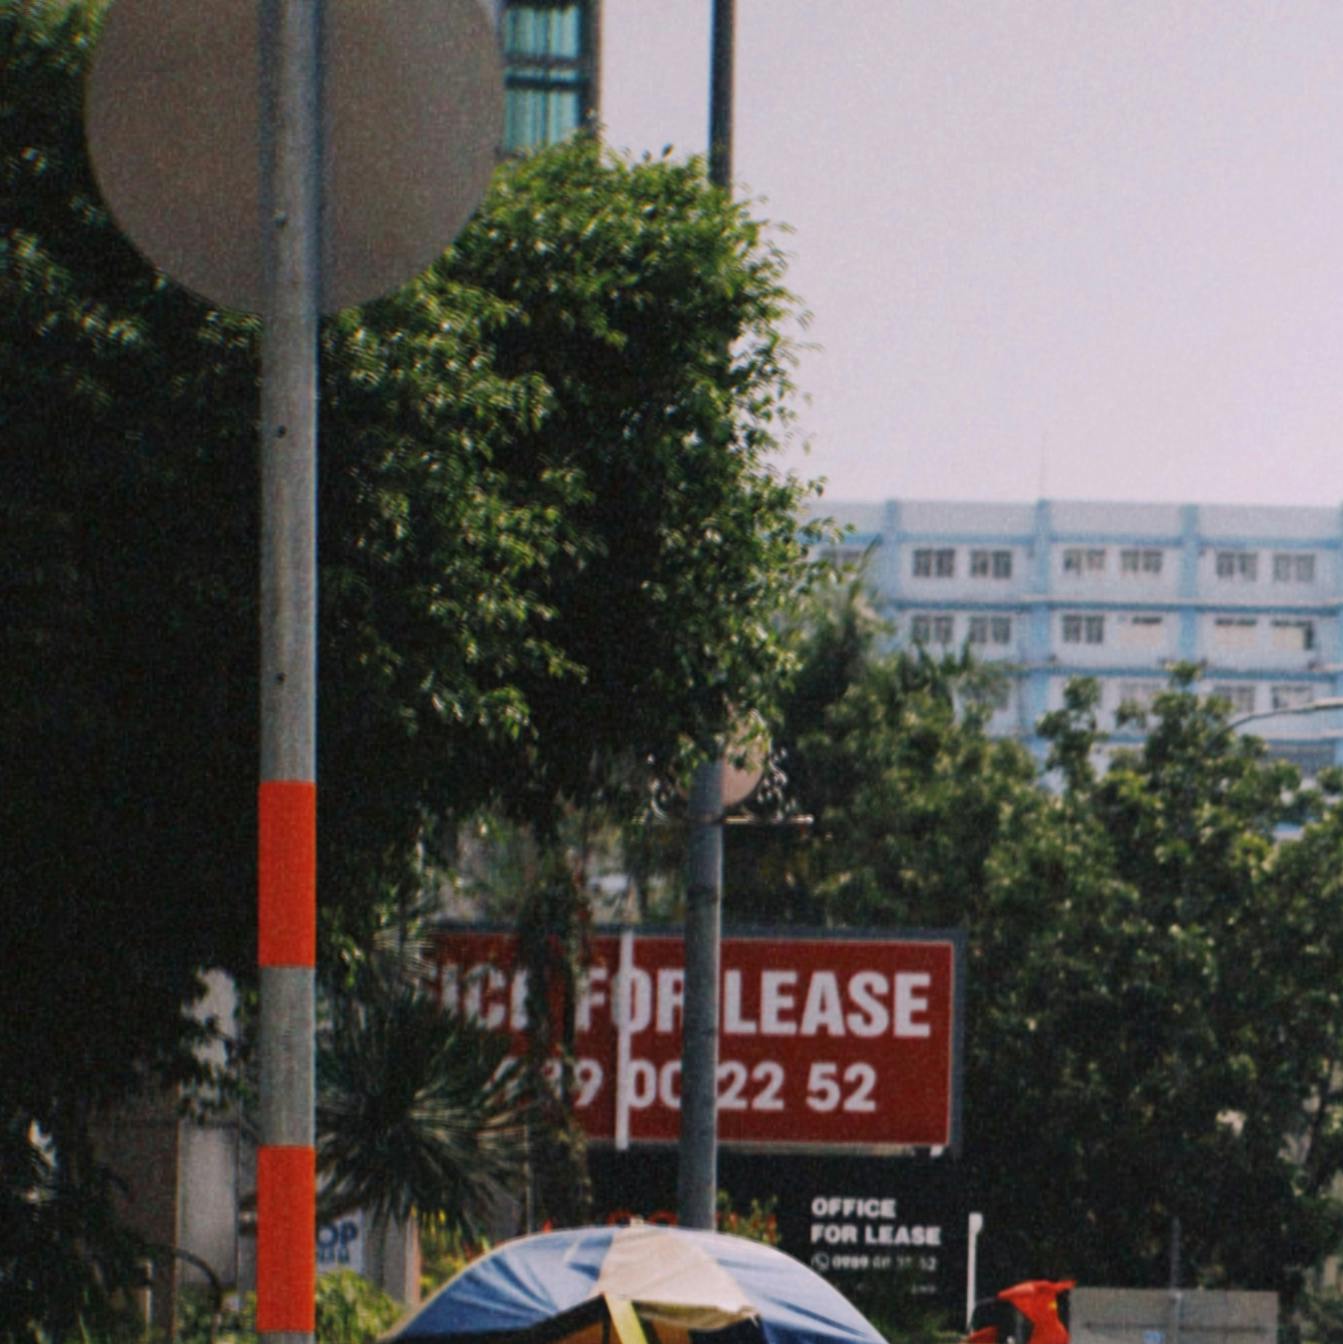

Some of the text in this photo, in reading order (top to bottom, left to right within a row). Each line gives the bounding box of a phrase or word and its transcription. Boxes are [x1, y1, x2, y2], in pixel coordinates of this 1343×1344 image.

[723, 970, 932, 1037] LEASE
[806, 1064, 877, 1113] 52
[811, 1197, 896, 1218] OFFICE
[810, 1225, 942, 1246] FOR LEASE
